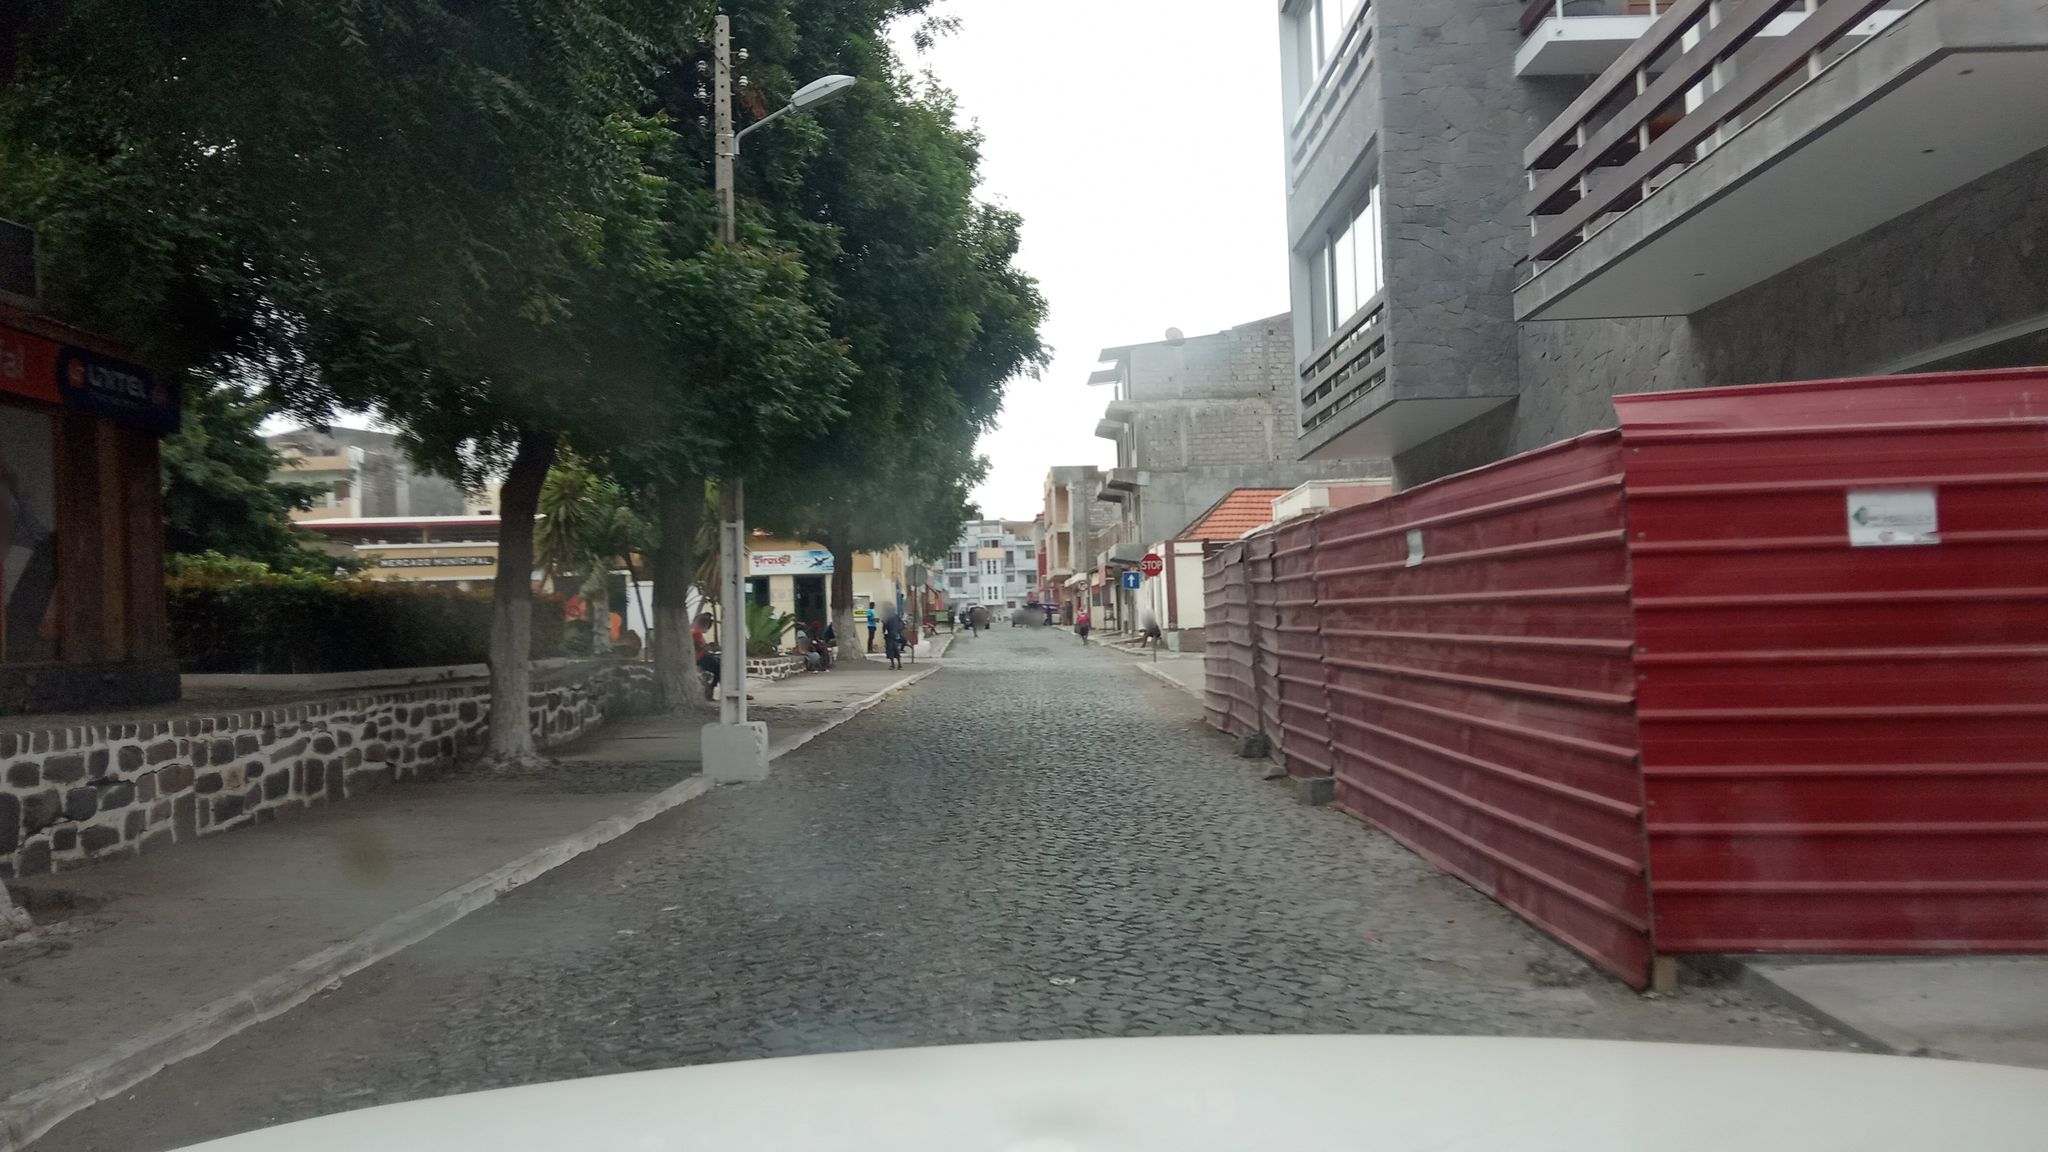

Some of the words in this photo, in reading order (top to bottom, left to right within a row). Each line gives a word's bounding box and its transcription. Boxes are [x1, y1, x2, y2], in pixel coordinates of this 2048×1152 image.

[380, 558, 431, 568] MERCADO
[433, 556, 492, 567] MUNICIPAL
[1141, 560, 1163, 570] STOP
